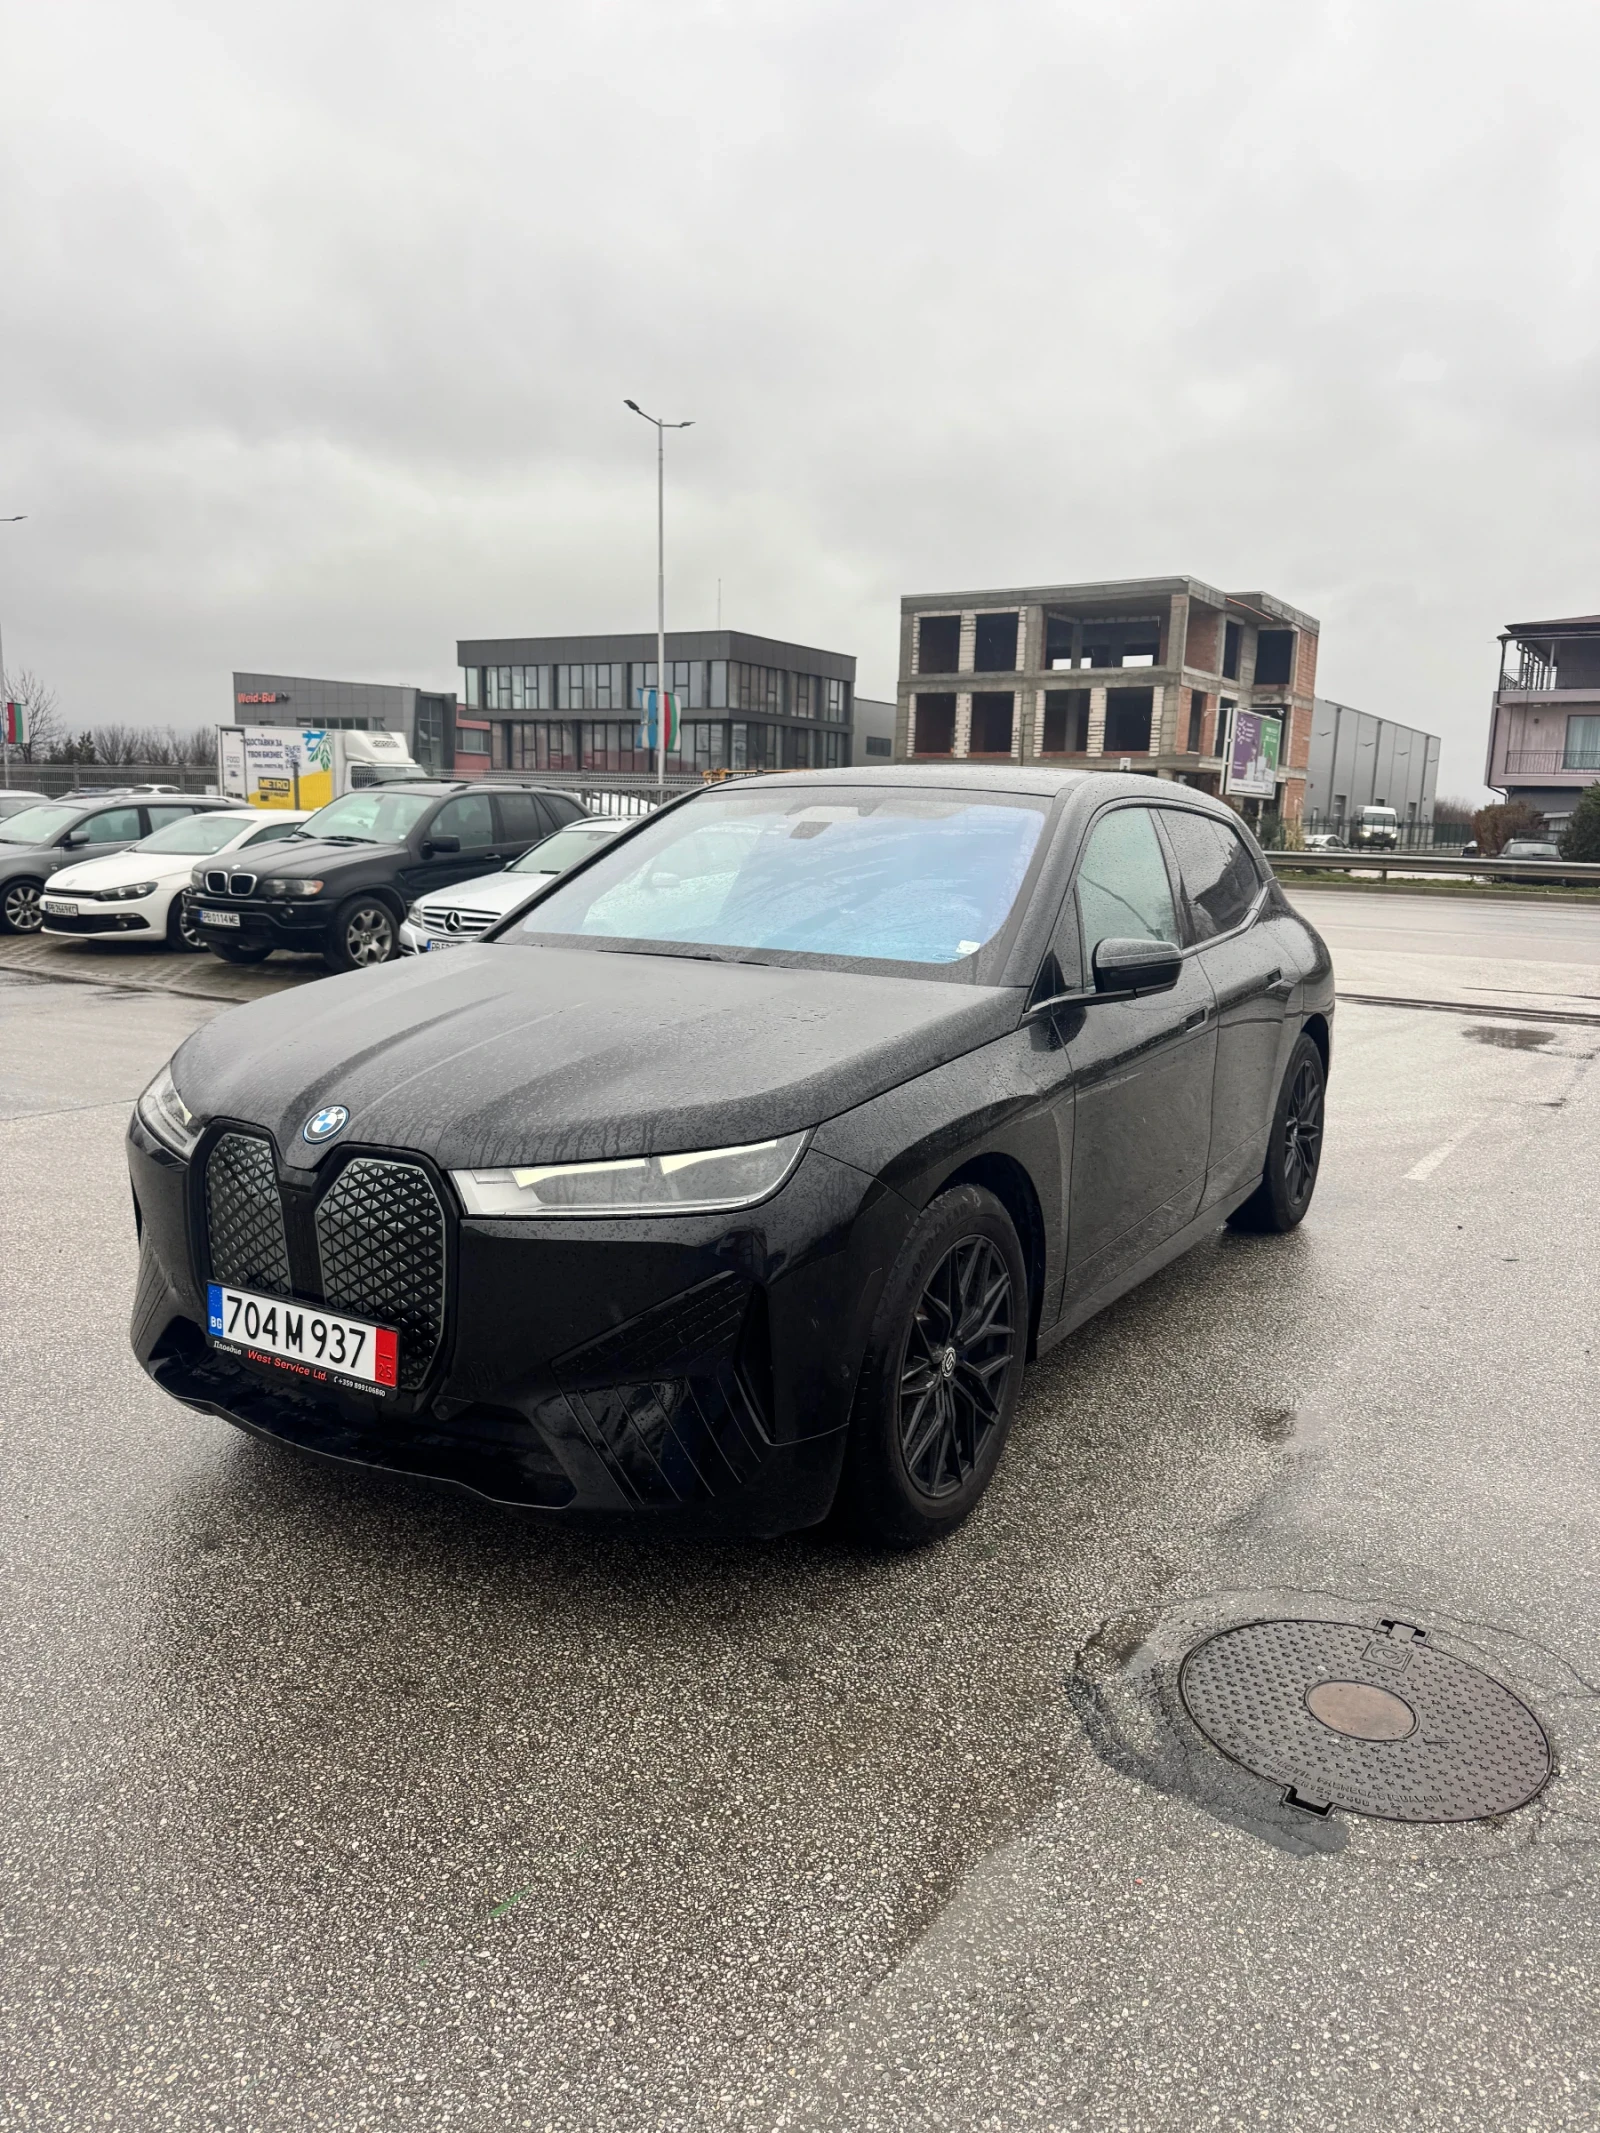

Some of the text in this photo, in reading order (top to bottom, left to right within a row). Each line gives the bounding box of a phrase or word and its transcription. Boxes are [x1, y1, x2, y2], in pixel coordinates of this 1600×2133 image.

[259, 778, 289, 790] METRO
[210, 1315, 223, 1329] BG
[248, 1349, 327, 1381] West Service Ltd.
